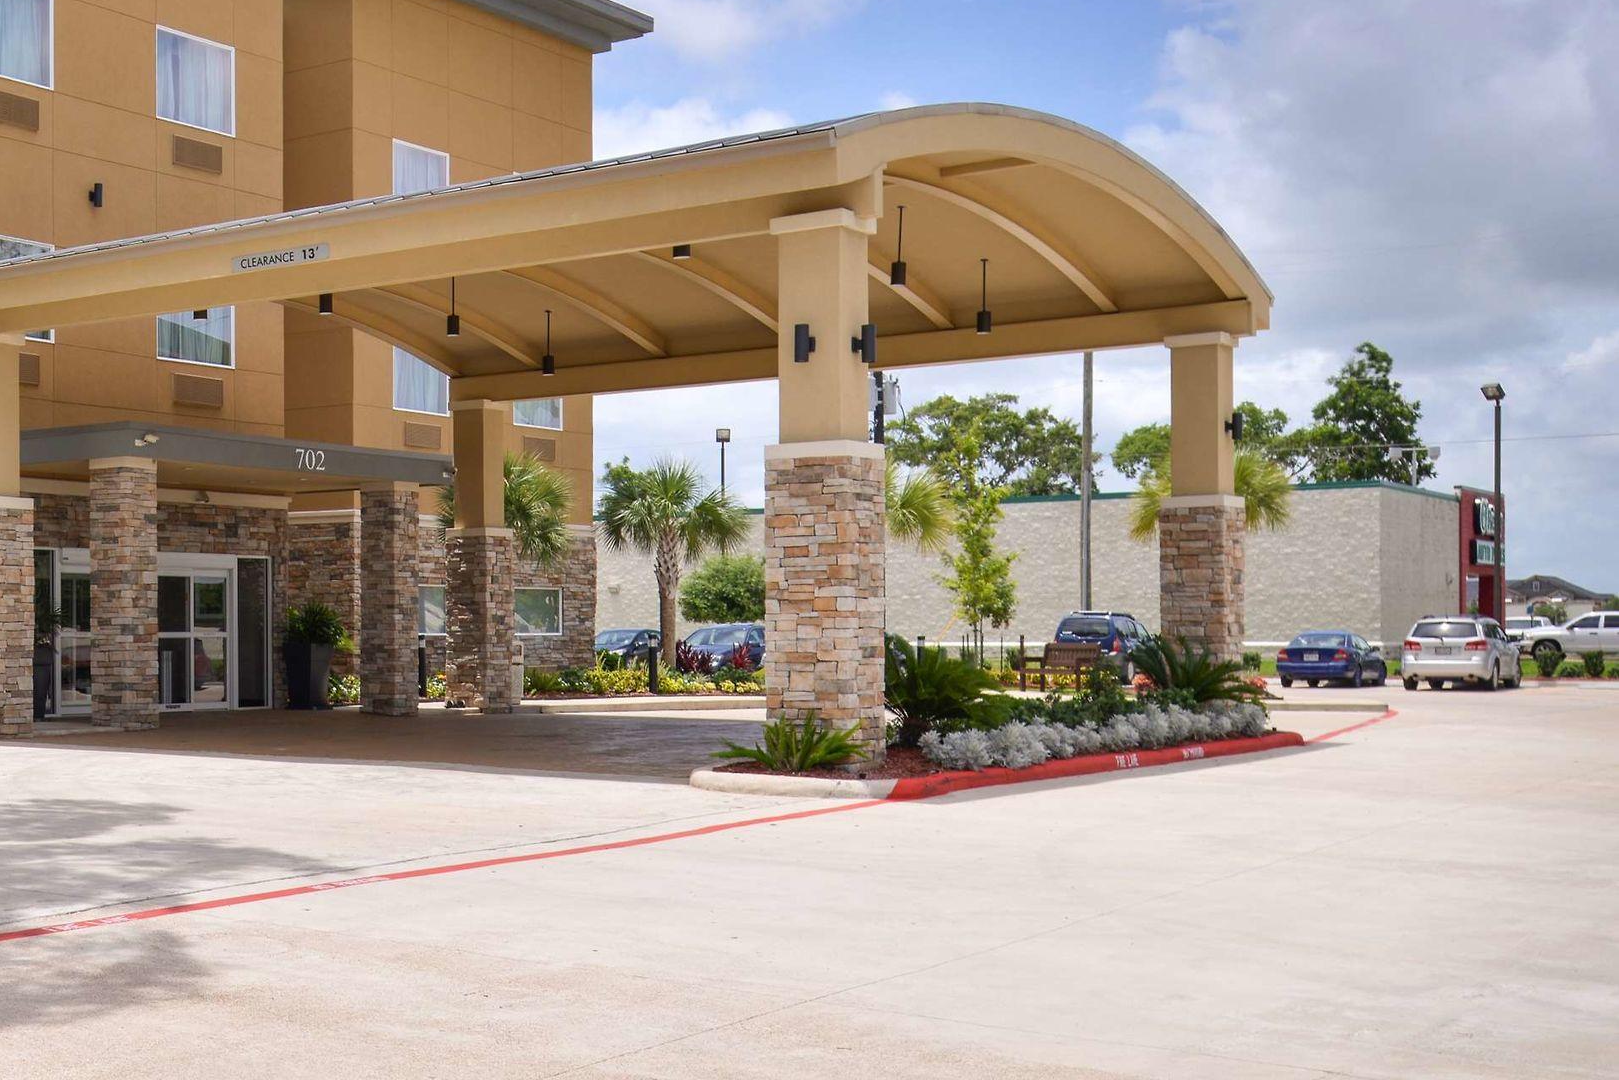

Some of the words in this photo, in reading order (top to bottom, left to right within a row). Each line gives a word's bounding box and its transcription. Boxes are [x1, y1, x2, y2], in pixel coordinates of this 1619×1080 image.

[240, 251, 294, 269] CLEARANCE
[302, 246, 319, 260] 13'
[295, 448, 325, 471] 702
